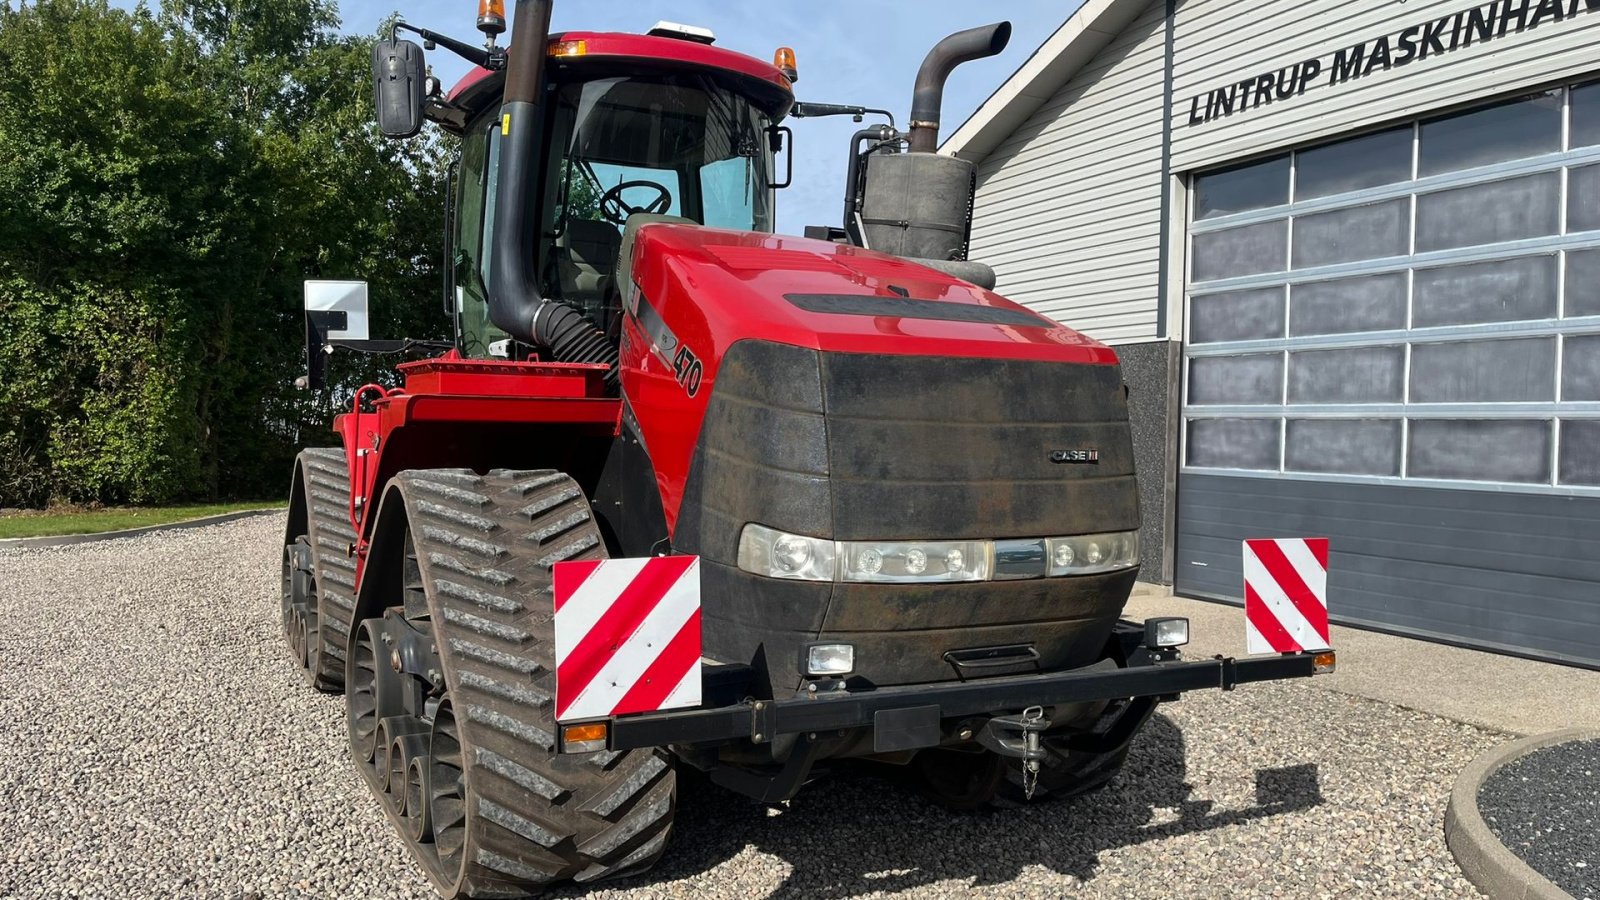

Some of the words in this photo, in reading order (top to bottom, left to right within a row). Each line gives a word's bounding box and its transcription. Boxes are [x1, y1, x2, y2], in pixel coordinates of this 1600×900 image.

[1188, 58, 1321, 126] LINTRUP
[673, 345, 702, 397] 470
[1052, 450, 1086, 461] CASE
